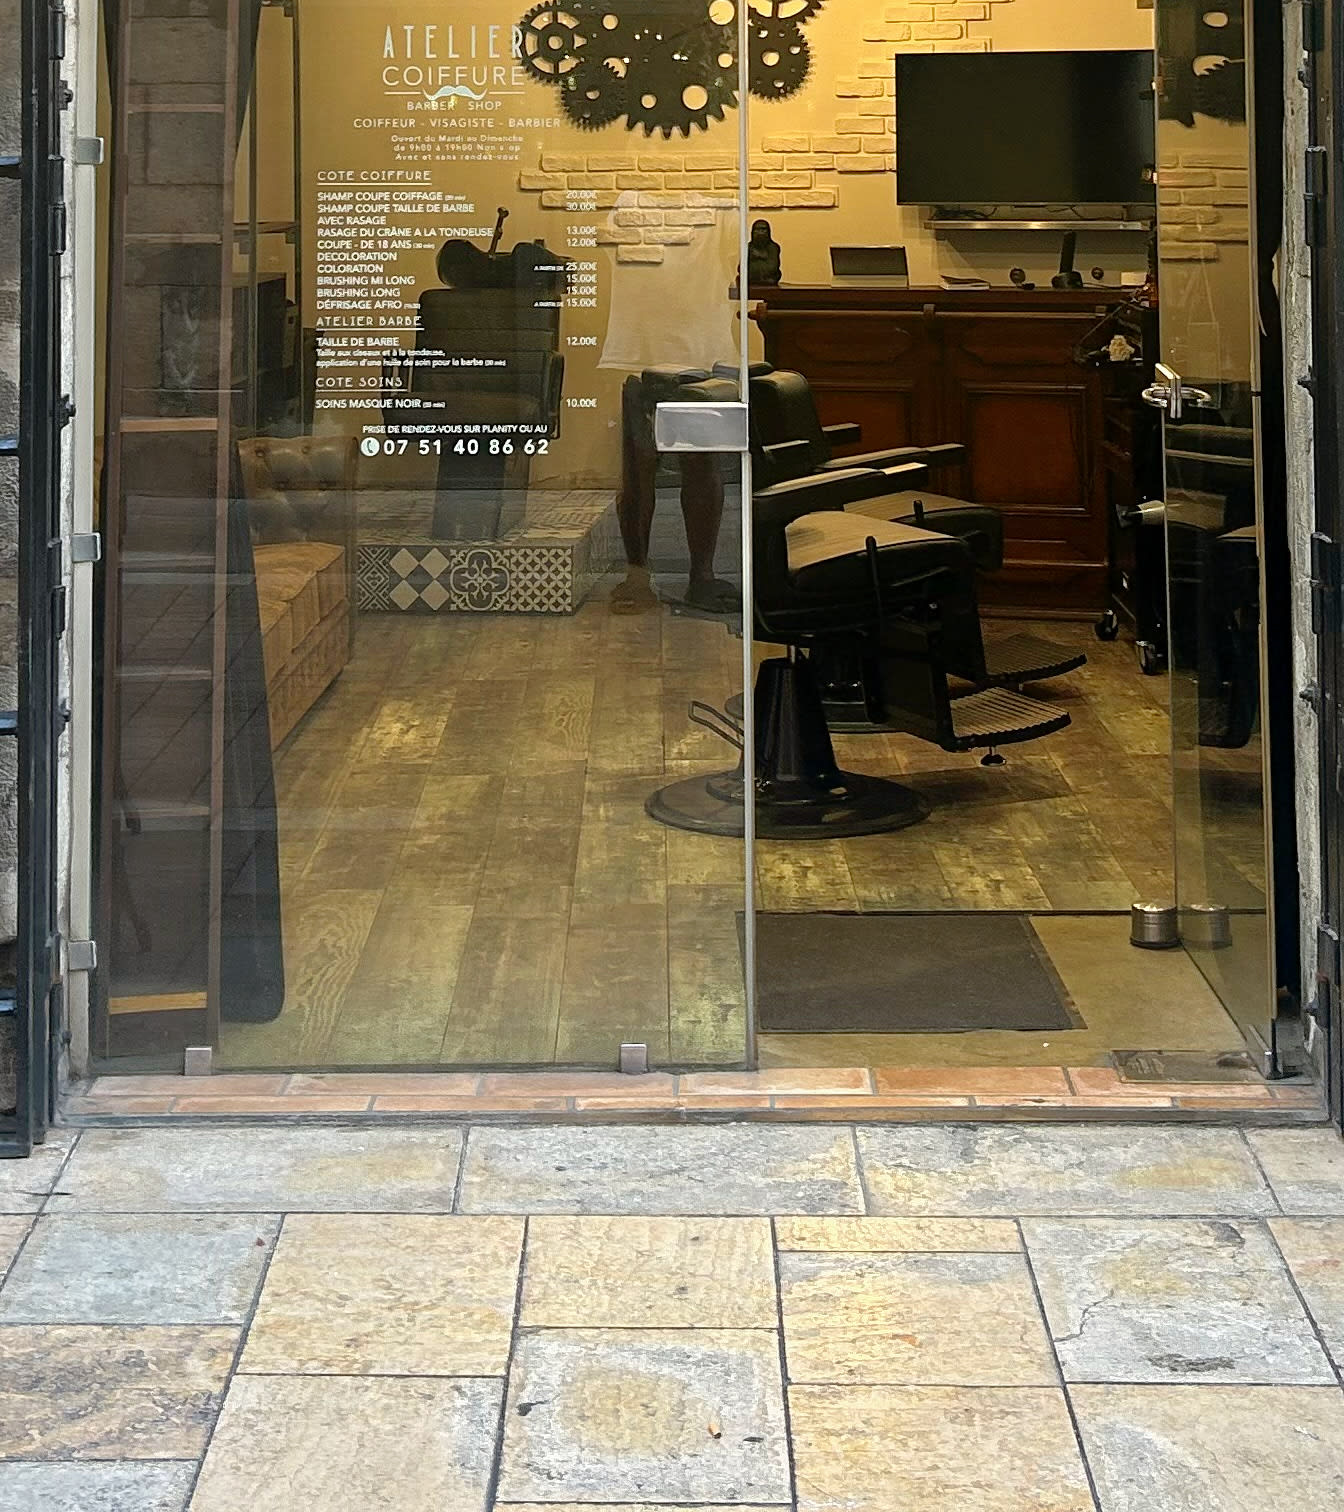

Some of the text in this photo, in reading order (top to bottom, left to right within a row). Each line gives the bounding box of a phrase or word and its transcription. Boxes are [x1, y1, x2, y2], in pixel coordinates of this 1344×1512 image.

[383, 25, 524, 59] ATELIER
[382, 66, 525, 86] COIFFURE
[407, 101, 502, 111] BARBER SHOP
[353, 118, 416, 128] COIFFEUR
[430, 118, 495, 128] VISAGISTE
[508, 118, 561, 128] BARBIER
[317, 171, 432, 181] COTE COIFFURE
[317, 192, 354, 201] SHAMP
[355, 192, 390, 201] COUPE
[392, 192, 443, 201] COIFFAGE
[317, 204, 475, 213] SHAMP COUPE TAILLE DE BARBE
[317, 216, 387, 225] AVEC RASAGE
[317, 228, 358, 237] RASAGE
[359, 228, 375, 237] DU
[423, 228, 437, 237] LA
[439, 228, 494, 237] TONDEUSE
[566, 226, 597, 235] 13.00€
[317, 240, 354, 249] COUPE
[360, 240, 375, 249] DE
[377, 240, 389, 249] 18
[390, 240, 413, 249] ANS
[566, 238, 597, 247] 12.00€
[317, 252, 398, 261] DECOLORATION
[317, 264, 384, 273] COLORATION
[565, 262, 597, 271] 25.00€
[317, 276, 416, 285] BRUSHING MI LONG
[566, 274, 597, 283] 15.00€
[317, 288, 401, 297] BRUSHING LONG
[317, 299, 372, 309] DÉFRISAGE
[374, 301, 402, 309] AFRO
[566, 298, 597, 307] 15.00€
[316, 316, 422, 326] ATELIER BARBE
[316, 337, 400, 346] TAILLE DE BARBE
[566, 337, 597, 346] 12.00€
[316, 377, 403, 387] COTE SOINS
[315, 399, 347, 408] SOINS
[349, 399, 393, 408] MASQUE
[395, 399, 421, 408] NOIR
[566, 398, 597, 408] 10.00€
[362, 425, 548, 434] PRISE DE RENDEZ-VOUS SUR PLANITY OU AU
[383, 439, 549, 455] 07 51 40 86 62
